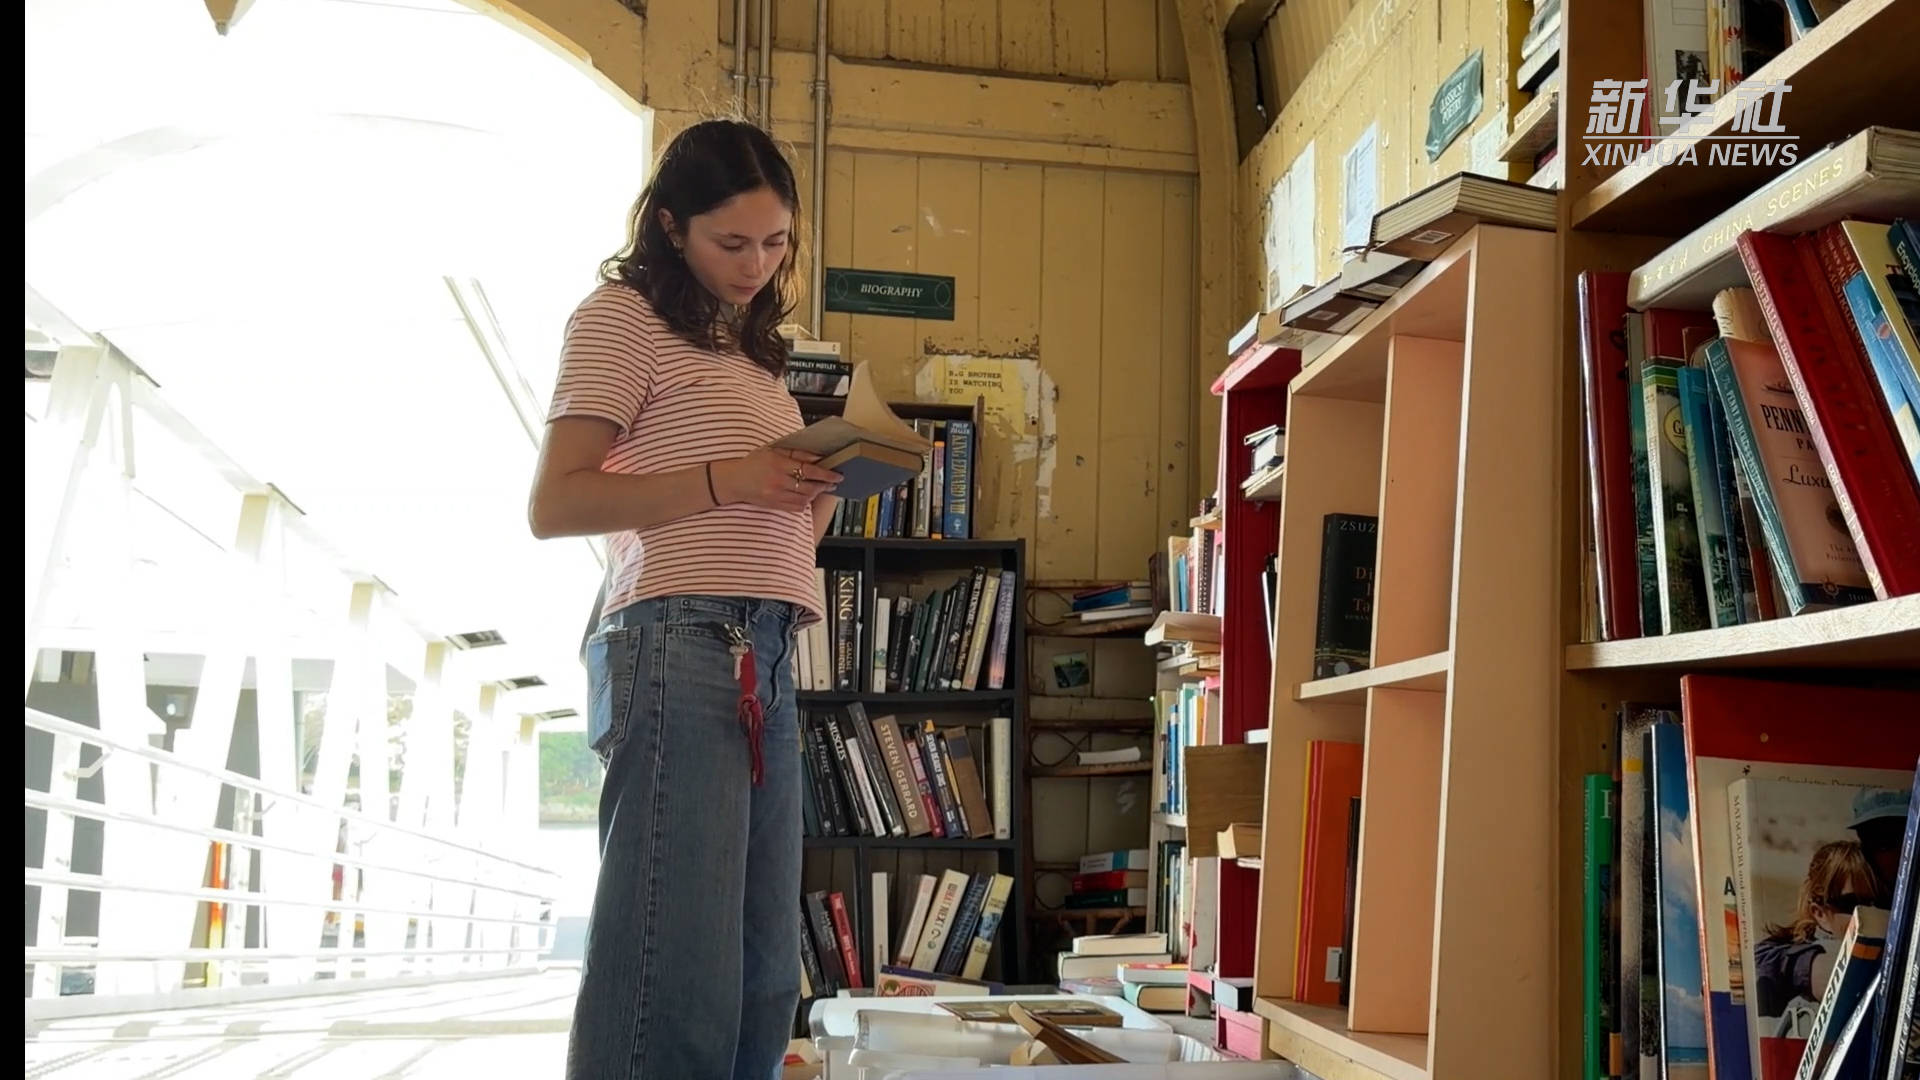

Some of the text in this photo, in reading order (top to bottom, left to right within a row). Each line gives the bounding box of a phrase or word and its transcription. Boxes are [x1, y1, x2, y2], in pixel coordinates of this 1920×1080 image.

[1702, 157, 1844, 253] CHINA SCENES
[860, 283, 923, 298] BIOGRAPHY
[963, 380, 1002, 388] WATCHING
[950, 435, 968, 514] KING EDWARD VIII
[840, 576, 854, 620] KING
[828, 721, 847, 760] MUSCLES
[881, 724, 900, 767] STEVEN
[896, 770, 918, 818] GERRARD
[1801, 943, 1848, 1079] Australia
